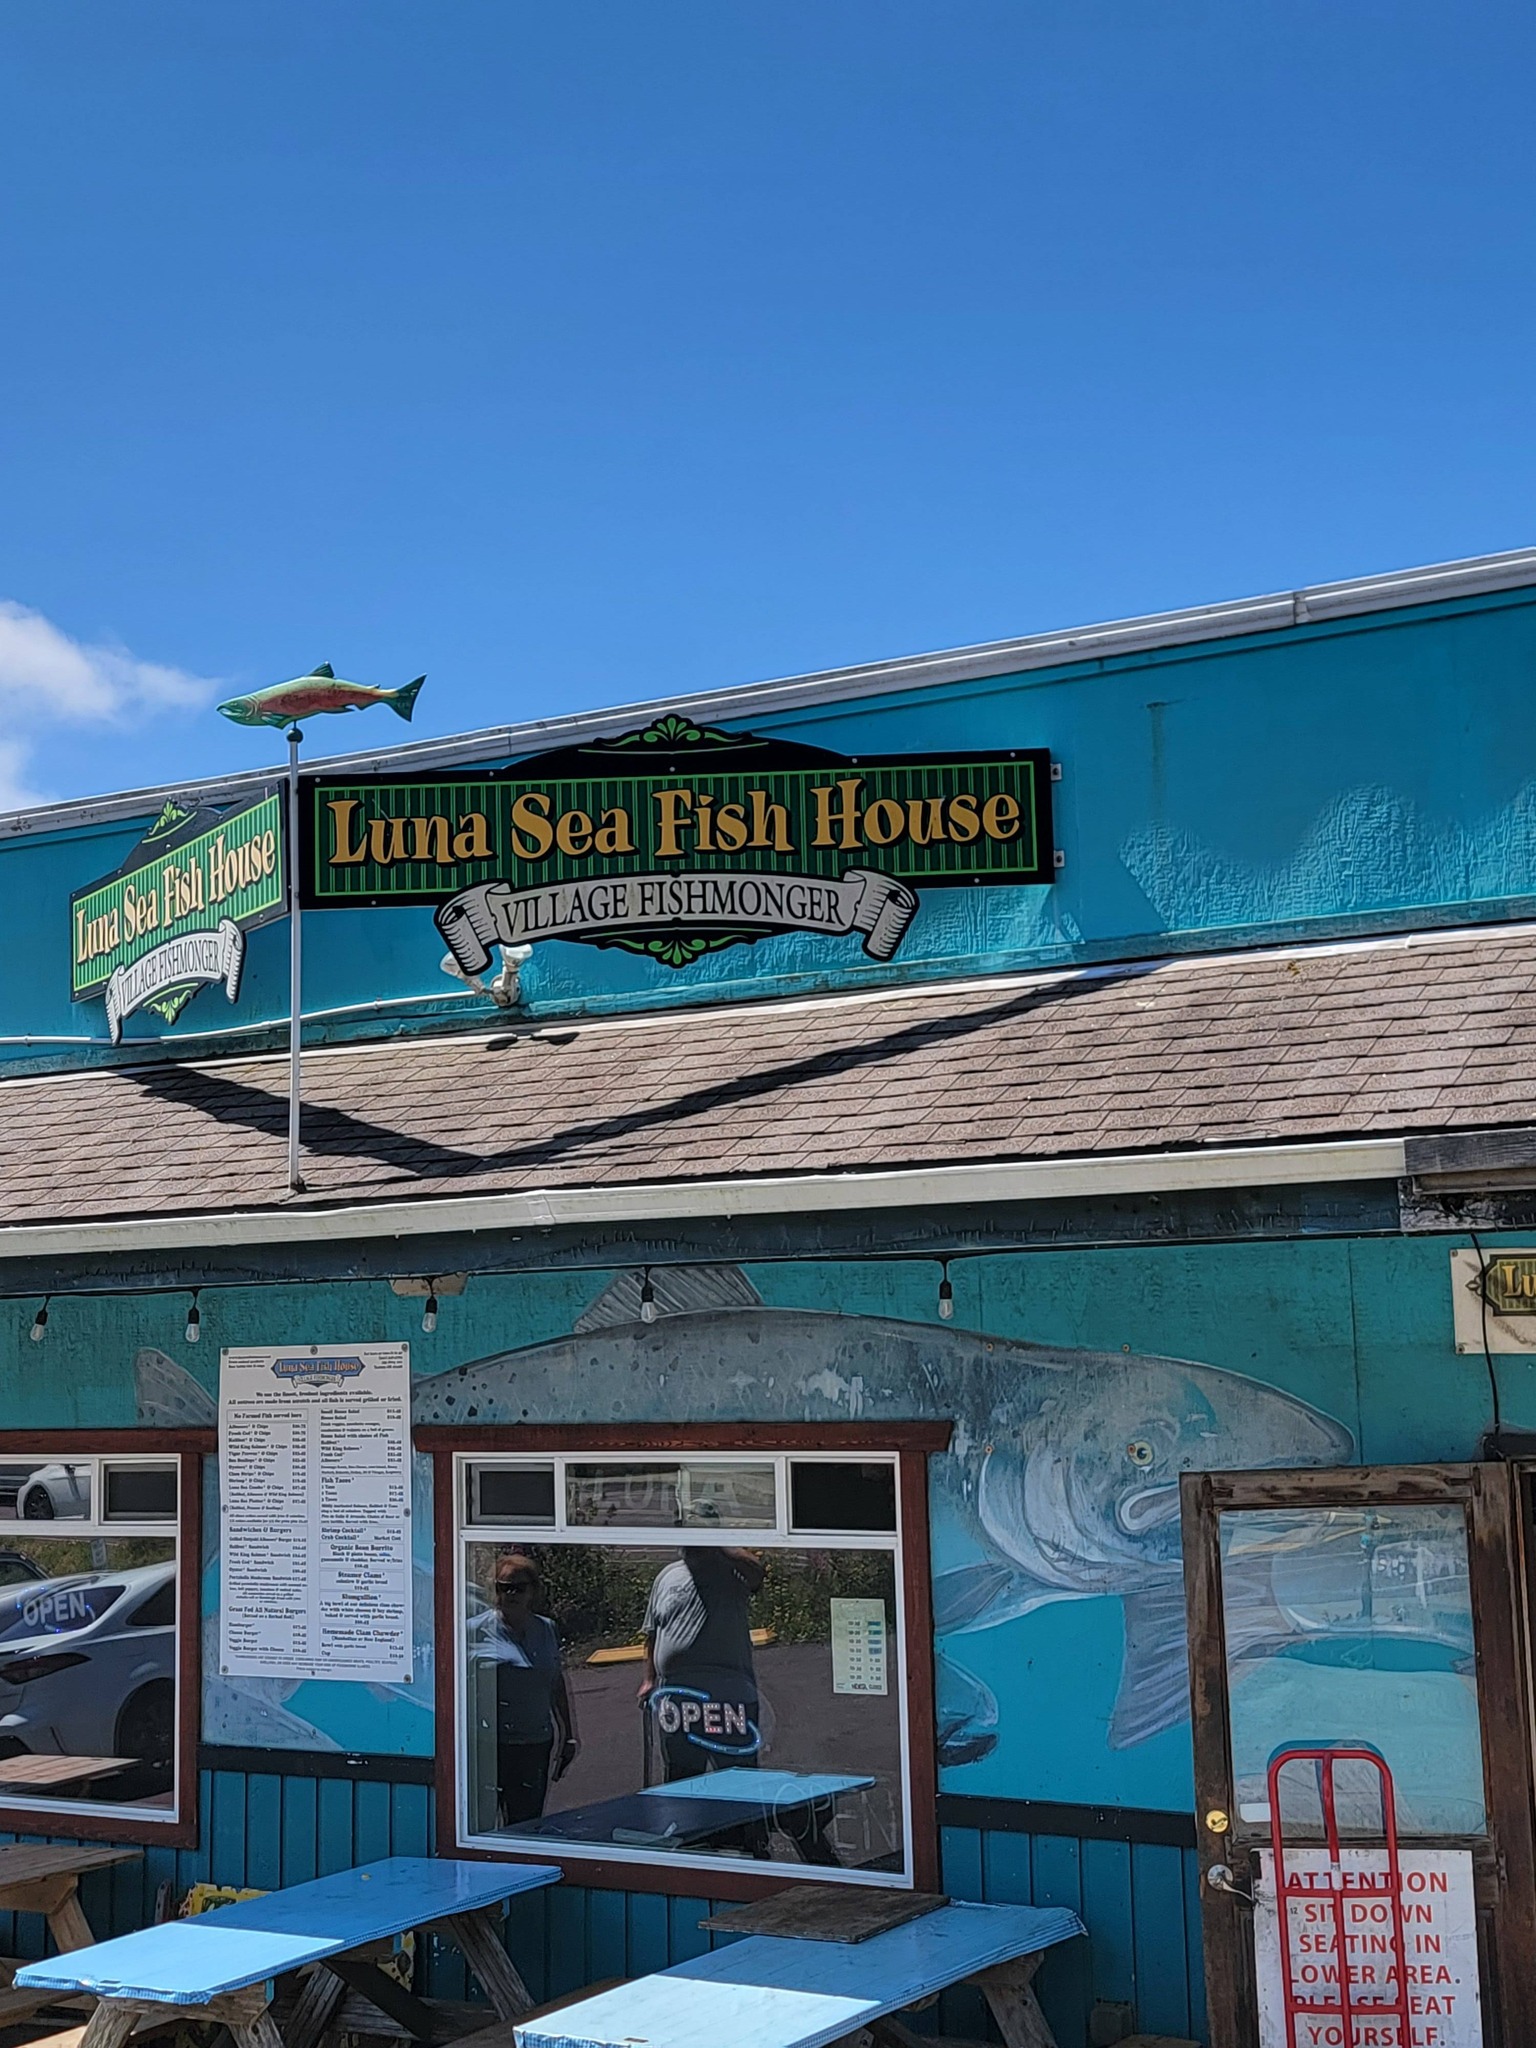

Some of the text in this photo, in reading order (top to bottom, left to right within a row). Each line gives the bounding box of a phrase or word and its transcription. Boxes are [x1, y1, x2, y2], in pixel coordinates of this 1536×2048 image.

[326, 778, 1021, 865] Luna Sea Fish House
[76, 829, 276, 964] Luna Sea Fish House
[501, 879, 845, 937] VILLAGE FISHMONGER
[120, 939, 220, 1005] VILLAGE FISHMONGER
[23, 1592, 86, 1627] OPEN
[659, 1698, 747, 1735] OPEN
[1415, 1934, 1441, 1953] IN
[1395, 1996, 1456, 2015] EAT
